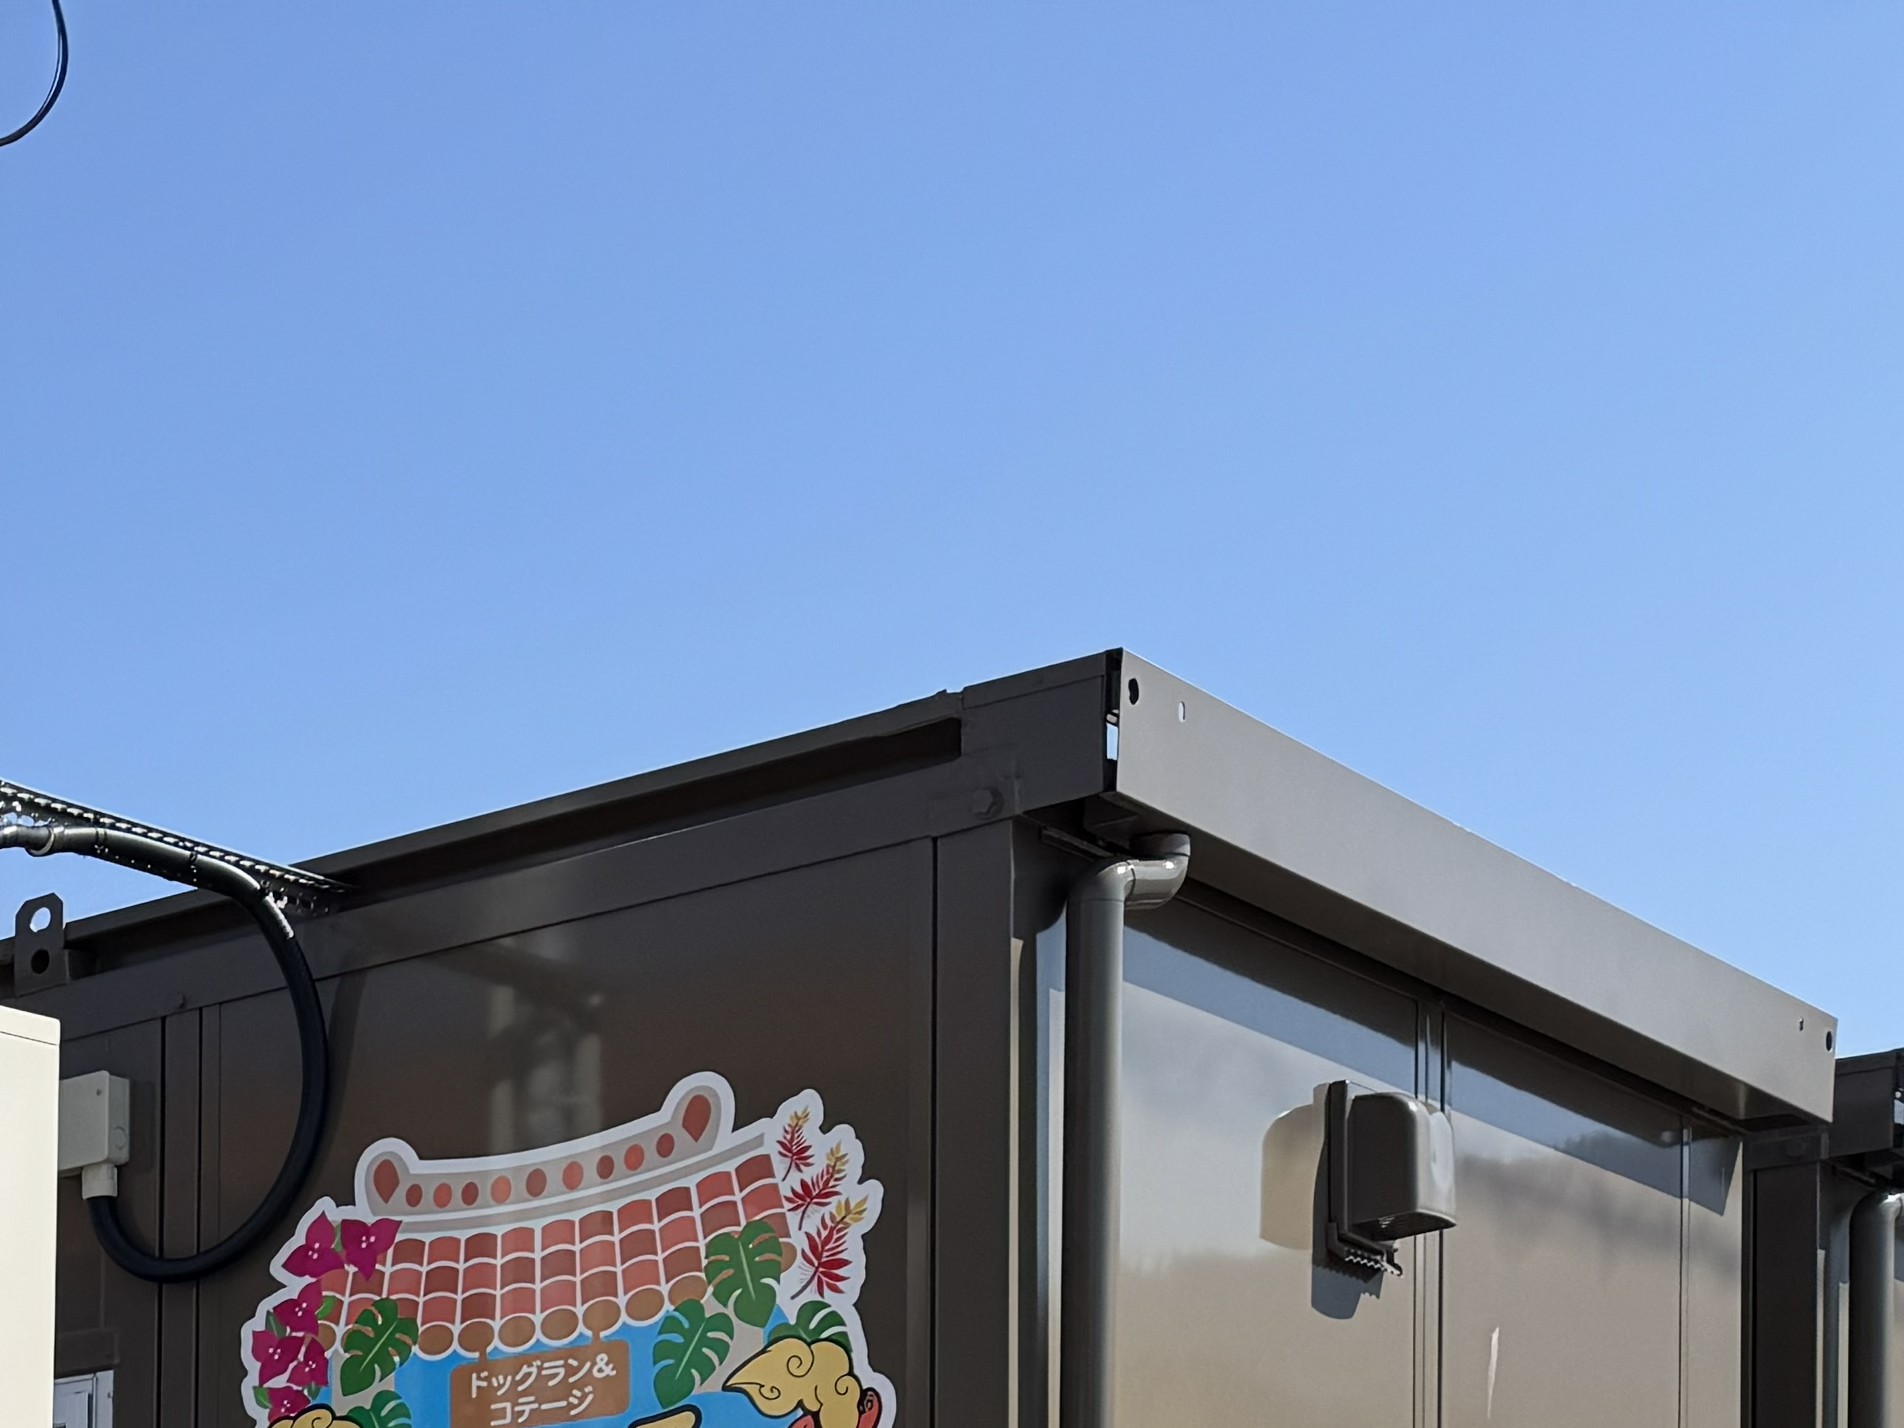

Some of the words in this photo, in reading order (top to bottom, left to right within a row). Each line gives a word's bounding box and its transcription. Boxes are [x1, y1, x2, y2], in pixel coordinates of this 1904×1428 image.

[471, 1353, 617, 1398] ドッグラン&
[490, 1385, 594, 1426] コテージ
